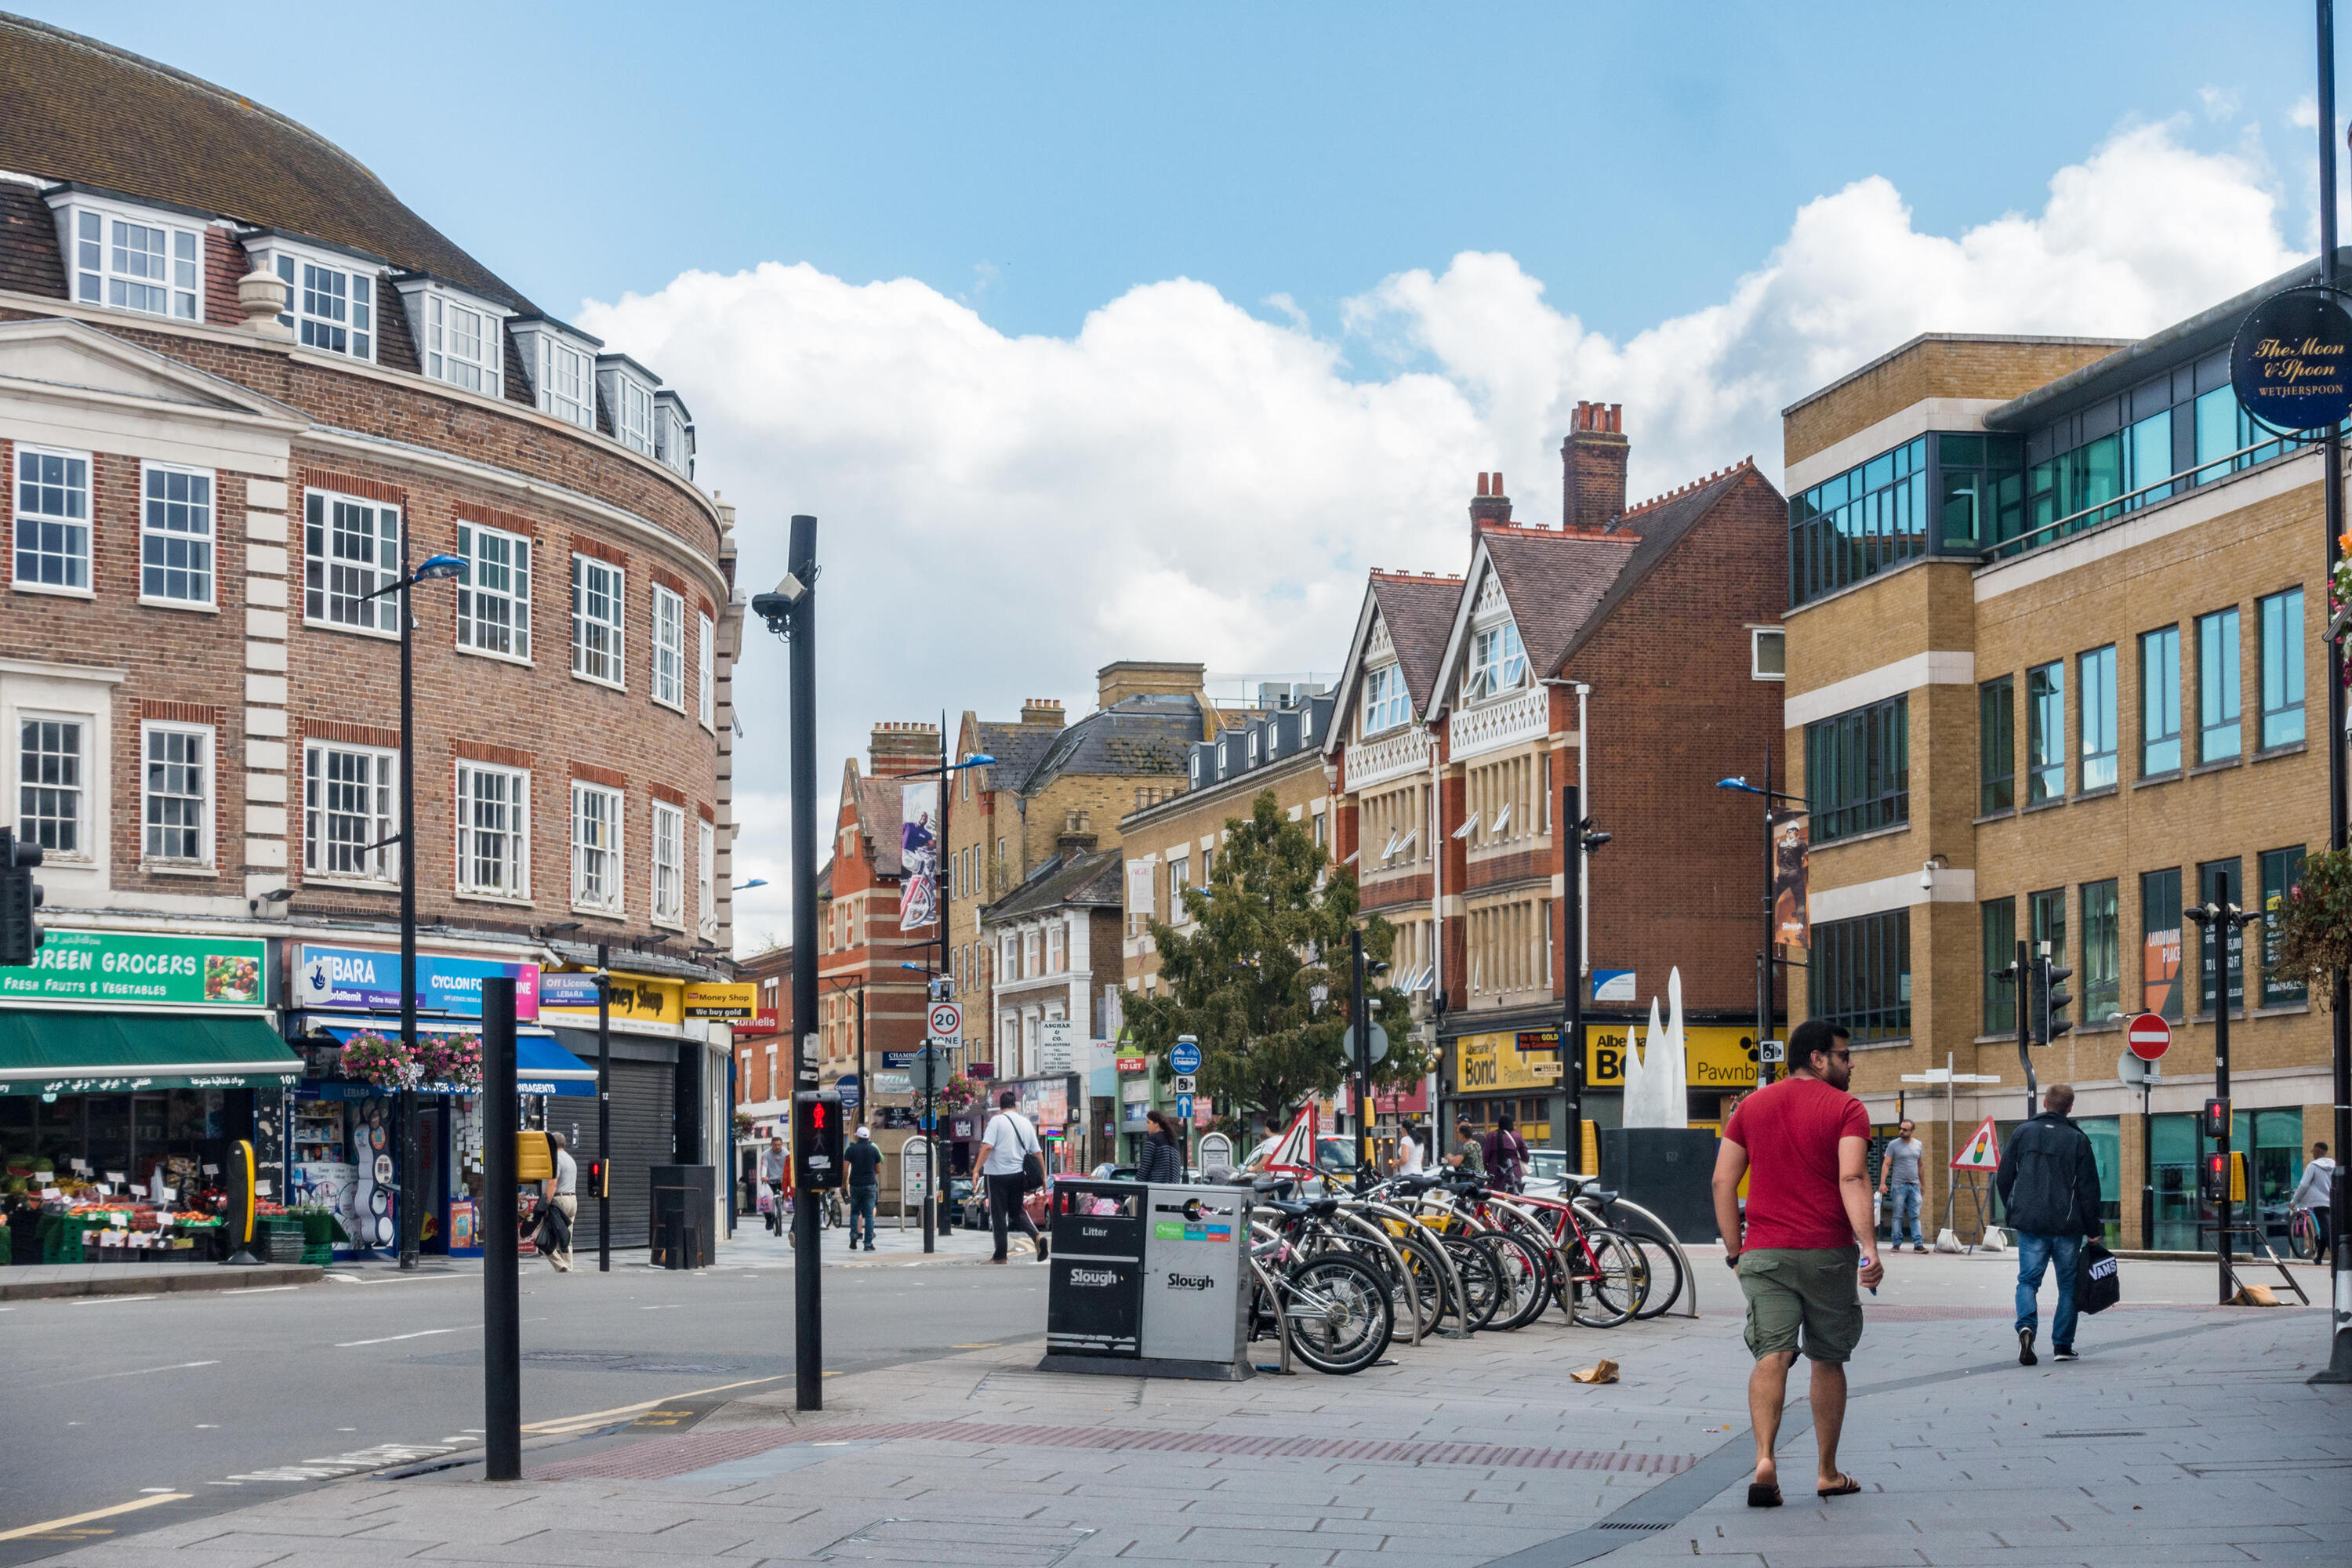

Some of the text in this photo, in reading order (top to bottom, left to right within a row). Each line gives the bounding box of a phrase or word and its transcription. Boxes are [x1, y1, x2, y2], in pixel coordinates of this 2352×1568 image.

[2255, 337, 2345, 358] The Moon
[2265, 359, 2336, 383] & Spoon
[2259, 384, 2343, 396] WETHERSPOON
[2148, 928, 2181, 947] LANDMARK
[102, 952, 196, 976] GROCERS
[2163, 946, 2181, 964] PLACE
[313, 955, 376, 984] BARA
[4, 977, 39, 991] FRESH
[45, 978, 86, 993] FRUITS
[102, 982, 167, 996] VEGETABLES
[432, 975, 470, 990] CYCLON
[516, 982, 532, 995] INE
[546, 978, 560, 988] Off
[637, 984, 663, 1017] Shop
[710, 1008, 723, 1017] buy
[724, 1008, 742, 1017] gold
[935, 1014, 956, 1025] 20
[1465, 1053, 1497, 1086] Bond
[279, 1075, 296, 1085] 101
[517, 1083, 556, 1094] WSAGENTS
[602, 1092, 609, 1101] 12
[1082, 1227, 1108, 1237] Litter
[1070, 1268, 1117, 1287] Slough
[2089, 1257, 2117, 1280] VANS
[1167, 1273, 1214, 1290] Slough
